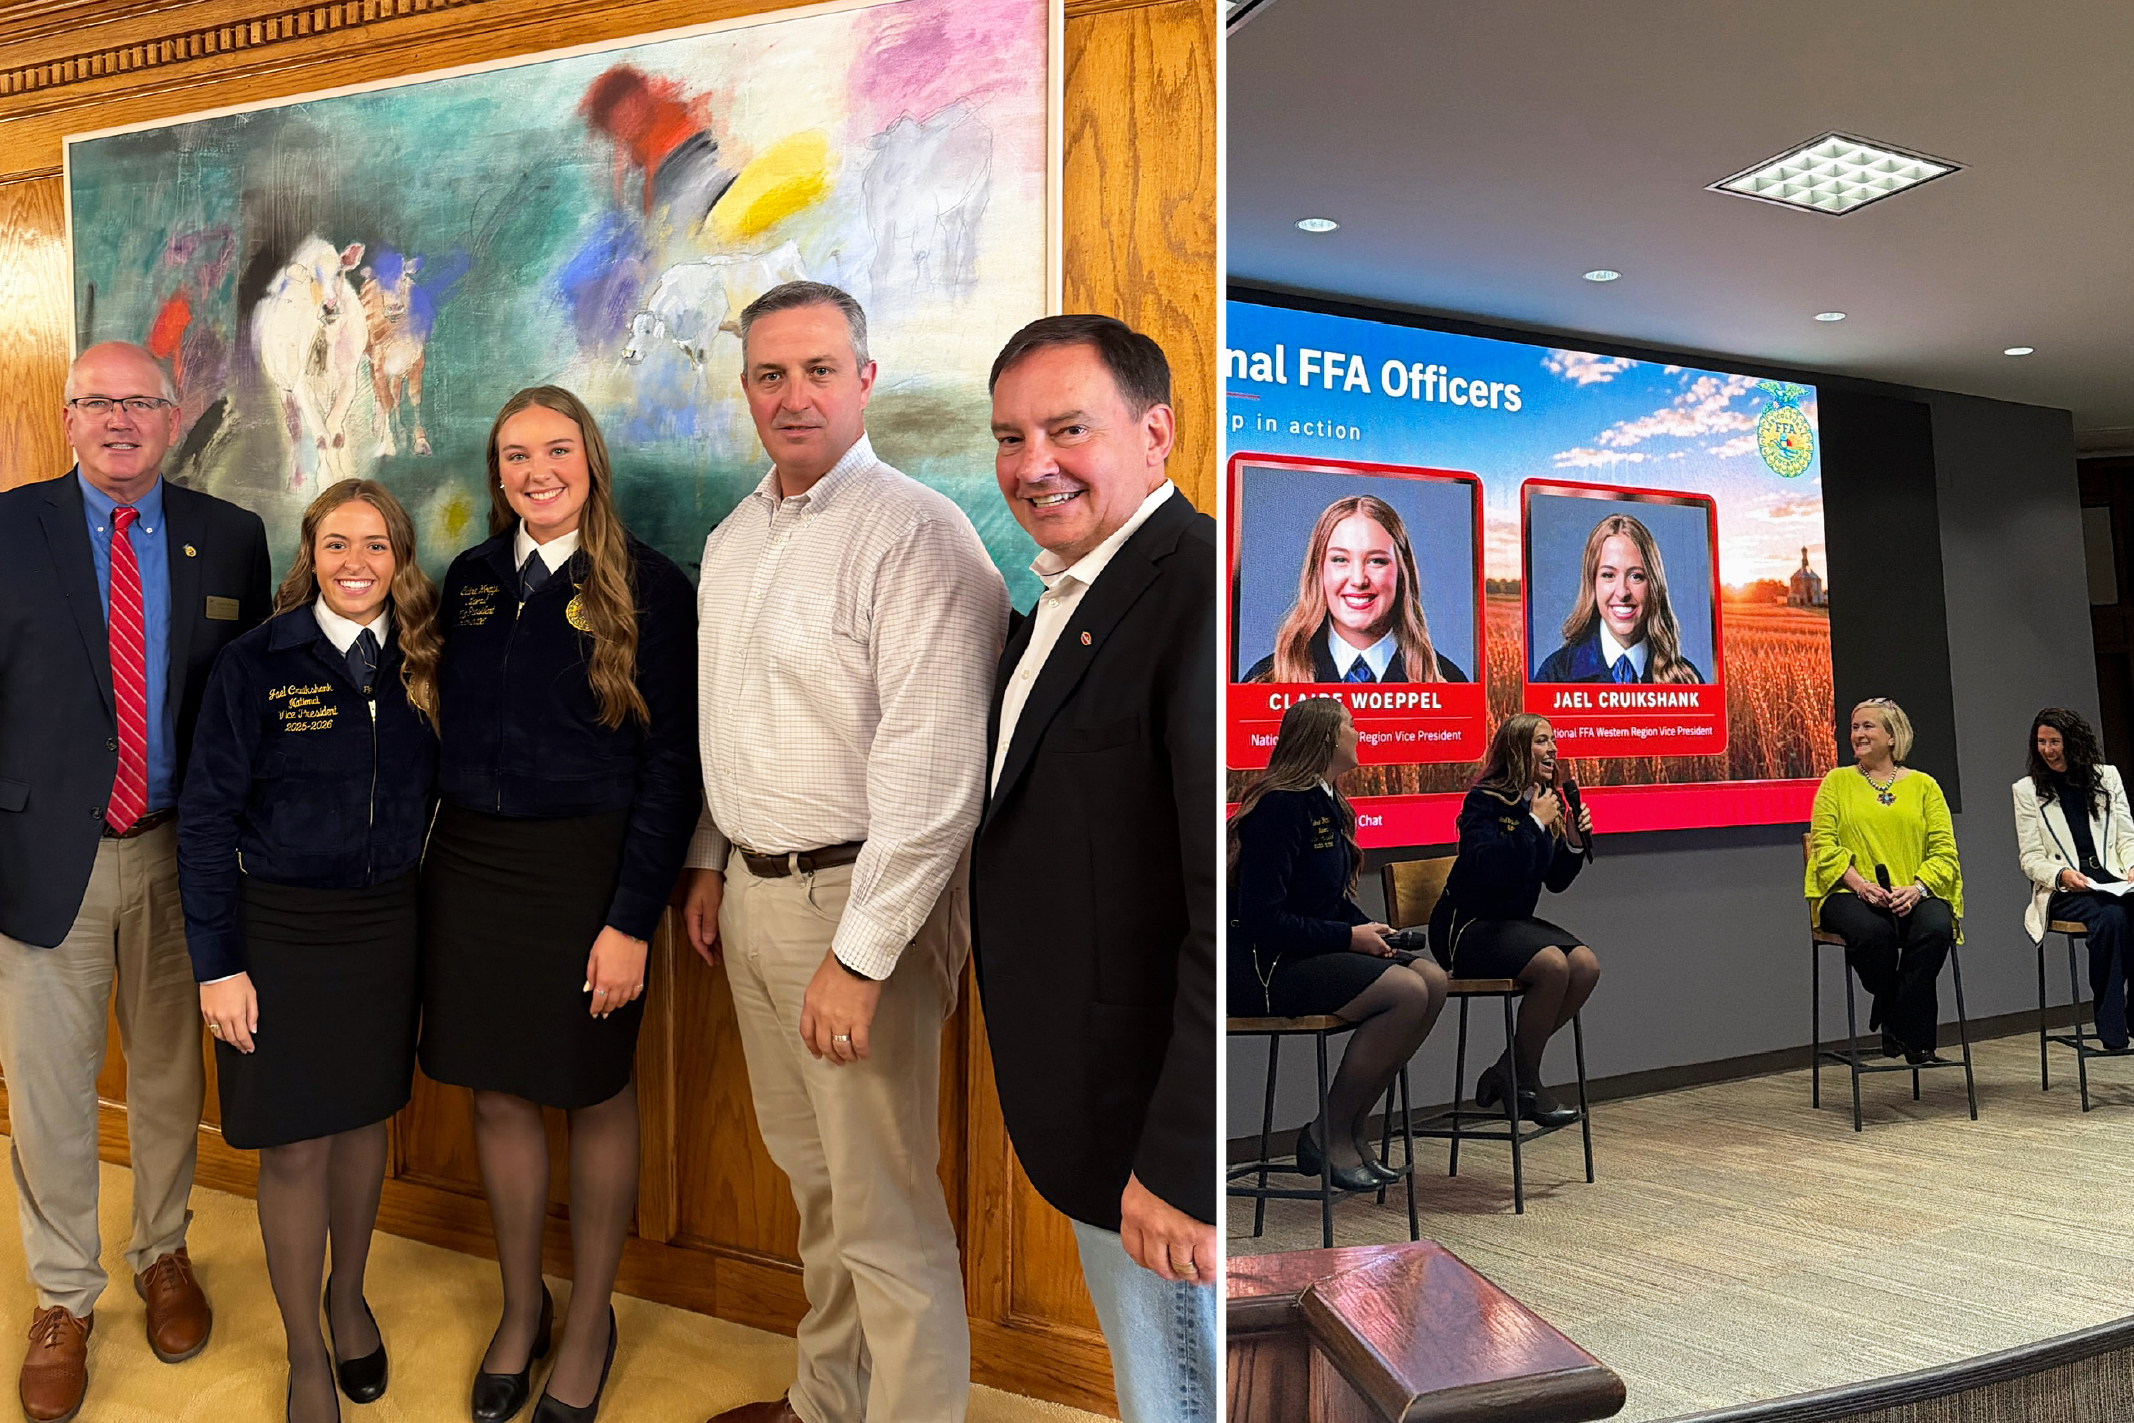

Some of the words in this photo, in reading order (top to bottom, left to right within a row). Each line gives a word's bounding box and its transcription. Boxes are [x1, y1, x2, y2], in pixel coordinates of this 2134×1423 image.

[1299, 348, 1372, 394] FFA
[1381, 359, 1523, 412] Officers
[1257, 412, 1278, 432] in
[1289, 419, 1361, 441] action
[1775, 422, 1797, 435] FFA
[288, 695, 321, 709] National
[1351, 692, 1442, 709] WOEPPEL
[1553, 691, 1593, 709] JAEL
[1598, 691, 1700, 708] CRUIKSHANK
[278, 709, 296, 720] Vice
[298, 704, 339, 719] President
[284, 718, 334, 732] 2025-2026
[1553, 727, 1577, 739] tional
[1578, 727, 1595, 738] FFA
[1596, 726, 1630, 737] Western
[1631, 725, 1659, 740] Region
[1659, 726, 1676, 736] Vice
[1677, 725, 1713, 737] President
[1251, 733, 1280, 747] Natio
[1359, 731, 1393, 746] Region
[1395, 730, 1416, 742] Vice
[1418, 729, 1462, 741] President
[1358, 815, 1383, 827] Chat
